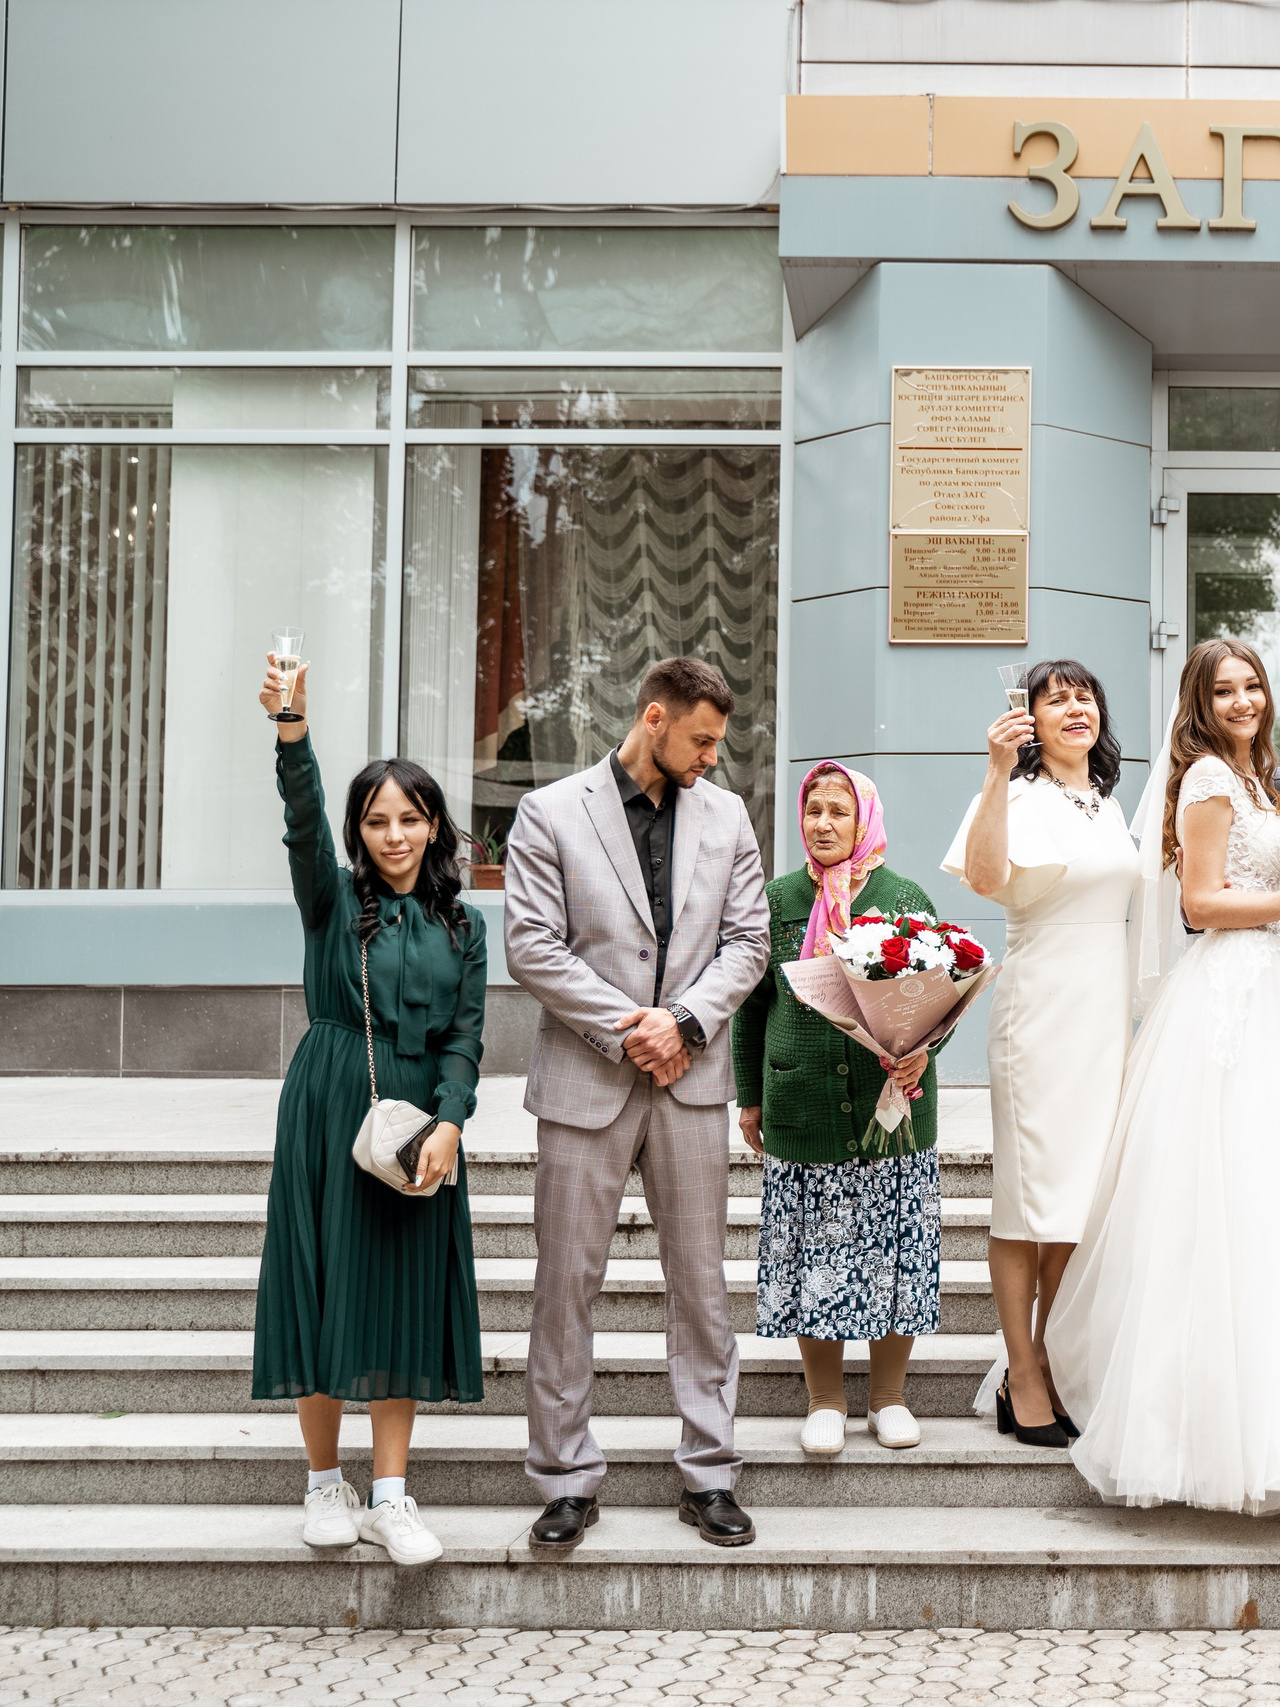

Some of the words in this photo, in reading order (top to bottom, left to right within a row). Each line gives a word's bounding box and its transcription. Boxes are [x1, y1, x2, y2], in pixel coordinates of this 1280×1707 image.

[902, 456, 980, 464] Государственный
[901, 468, 953, 476] Республики
[955, 468, 1020, 477] Башкортостан
[934, 491, 960, 499] Отдел
[930, 515, 962, 523] района
[972, 515, 990, 524] Уфа
